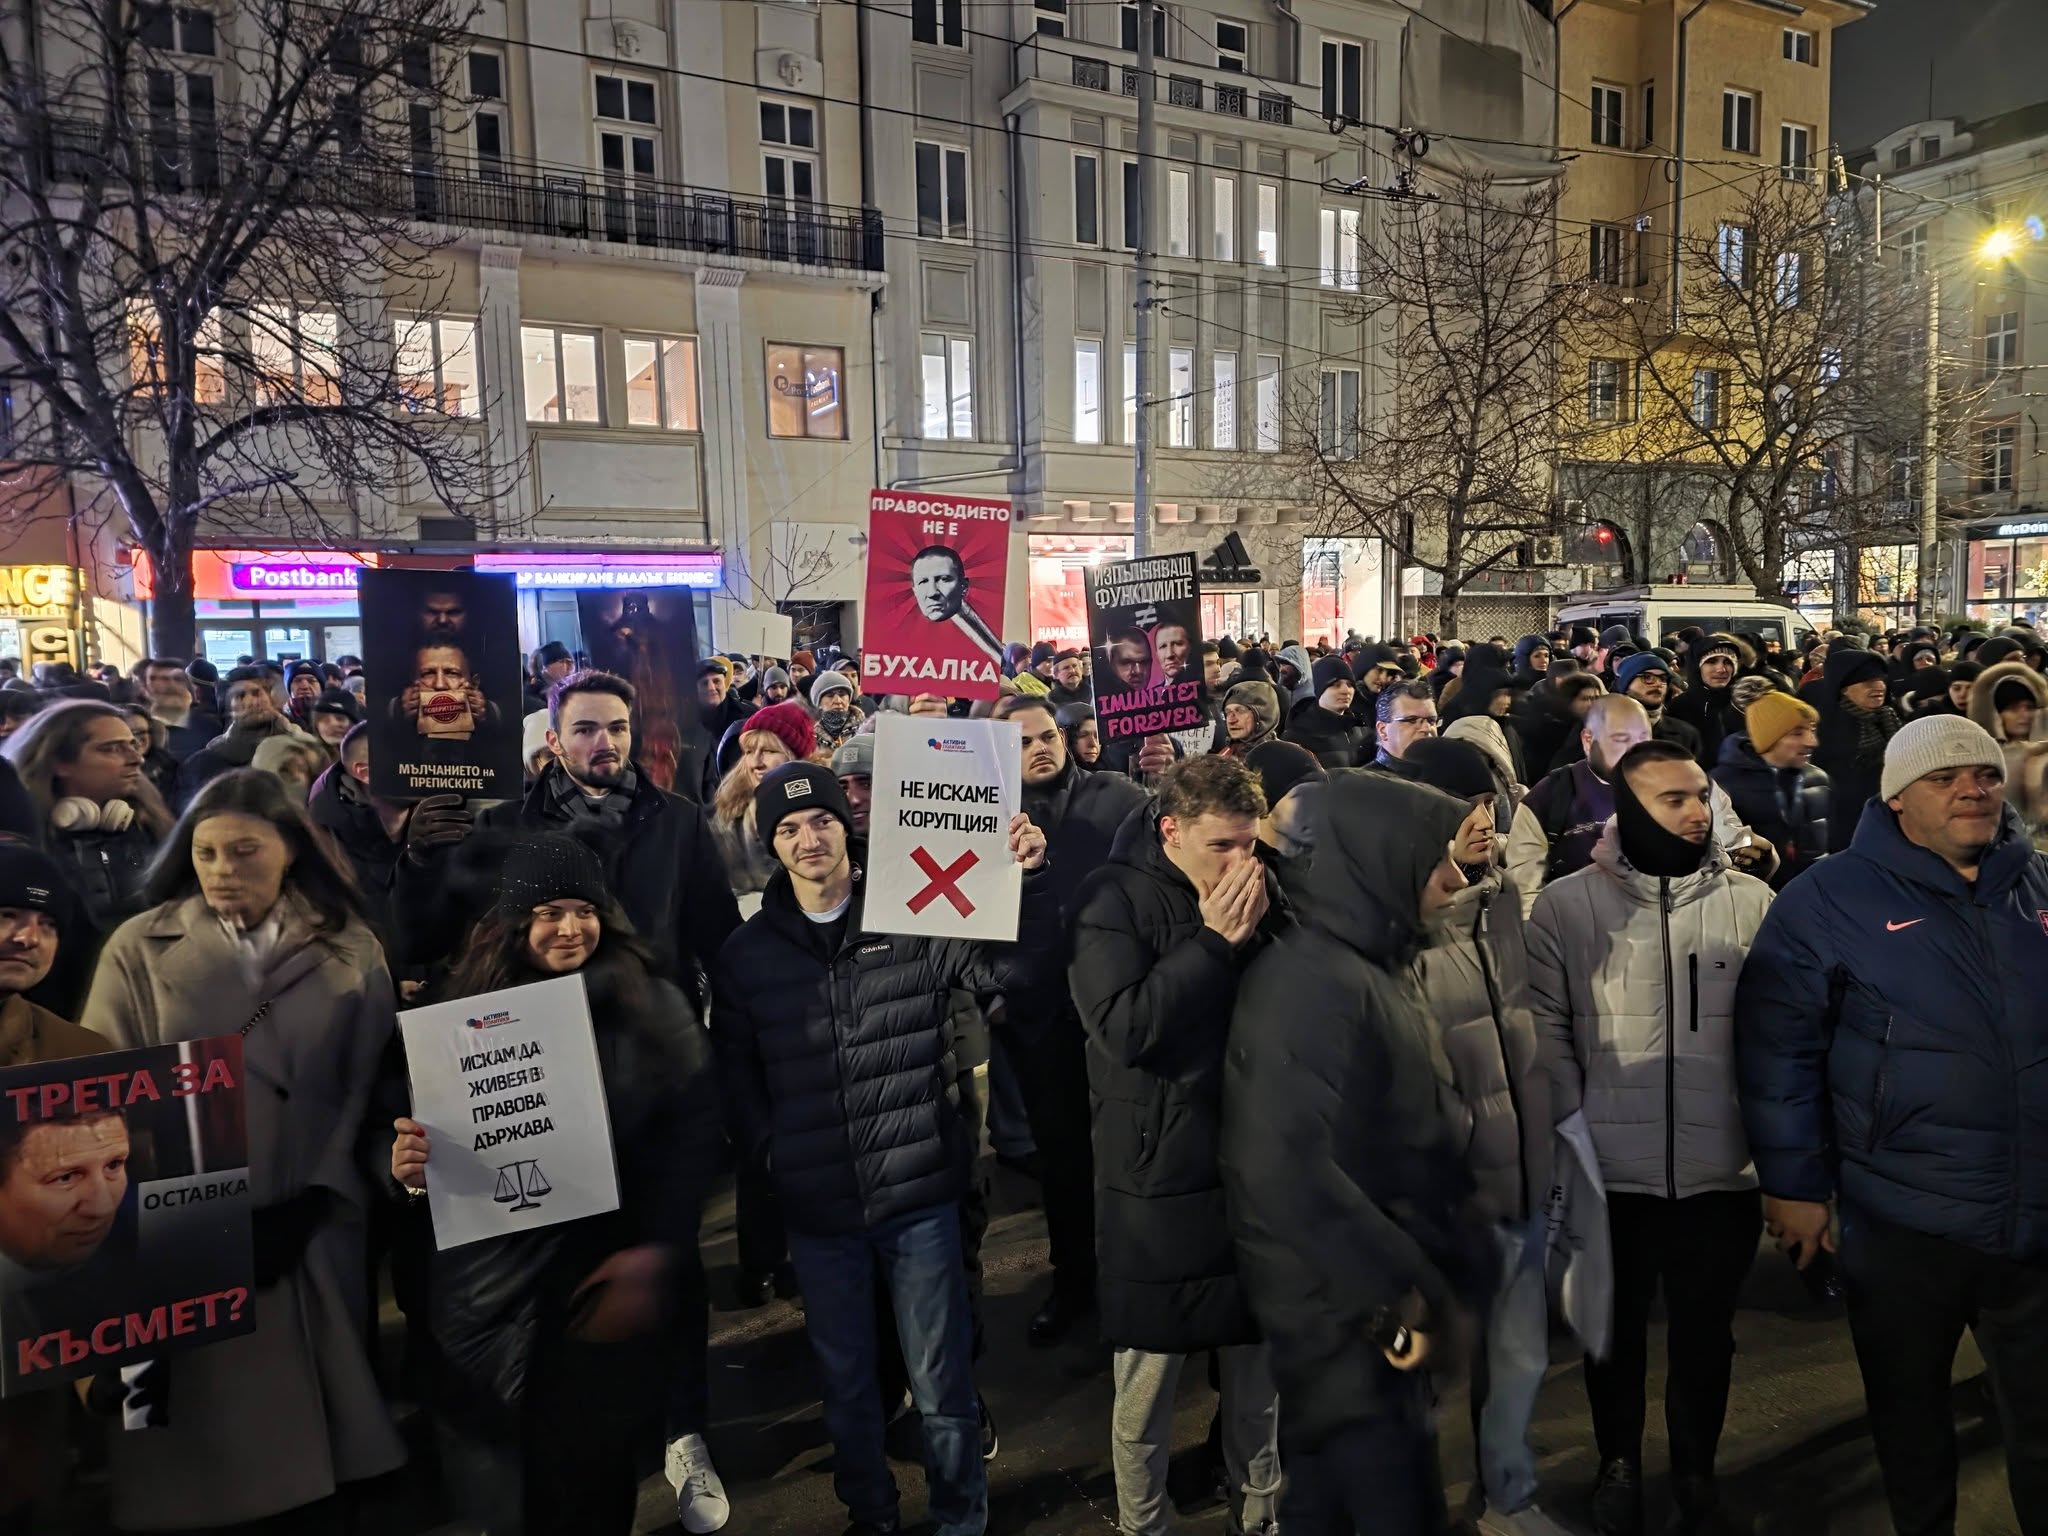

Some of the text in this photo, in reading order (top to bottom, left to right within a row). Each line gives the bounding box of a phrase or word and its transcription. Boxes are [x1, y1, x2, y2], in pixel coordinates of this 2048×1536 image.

[872, 497, 1010, 522] ПРАВОСЪДИЕТО
[923, 520, 958, 536] НЕ Е
[250, 567, 358, 586] Postbank
[535, 572, 614, 584] БАНКИРАНЕ
[616, 572, 663, 584] МАЛЪК
[666, 572, 714, 584] БИЗНЕС
[1095, 577, 1194, 609] ФУНКЦИИТЕ
[863, 653, 998, 683] БУХАЛКА
[1098, 680, 1200, 716] IMUNITET
[399, 763, 495, 777] МЪЛЧАНИЕТО НА
[410, 777, 484, 789] ПРЕПИСКИТЕ
[900, 780, 999, 804] НЕ ИСКАМЕ
[898, 809, 998, 834] КОРУПЦИЯ!
[460, 1041, 543, 1073] ИСКАМ ДА
[5, 1057, 235, 1122] ТРЕТА ЗА
[468, 1066, 544, 1098] ЖИВЕЯ В
[472, 1092, 548, 1124] ПРАВОВА
[473, 1117, 555, 1152] ДЪРЖАВА
[143, 1178, 249, 1211] ОСТАВКА
[17, 1287, 248, 1376] КЪСМЕТ?
